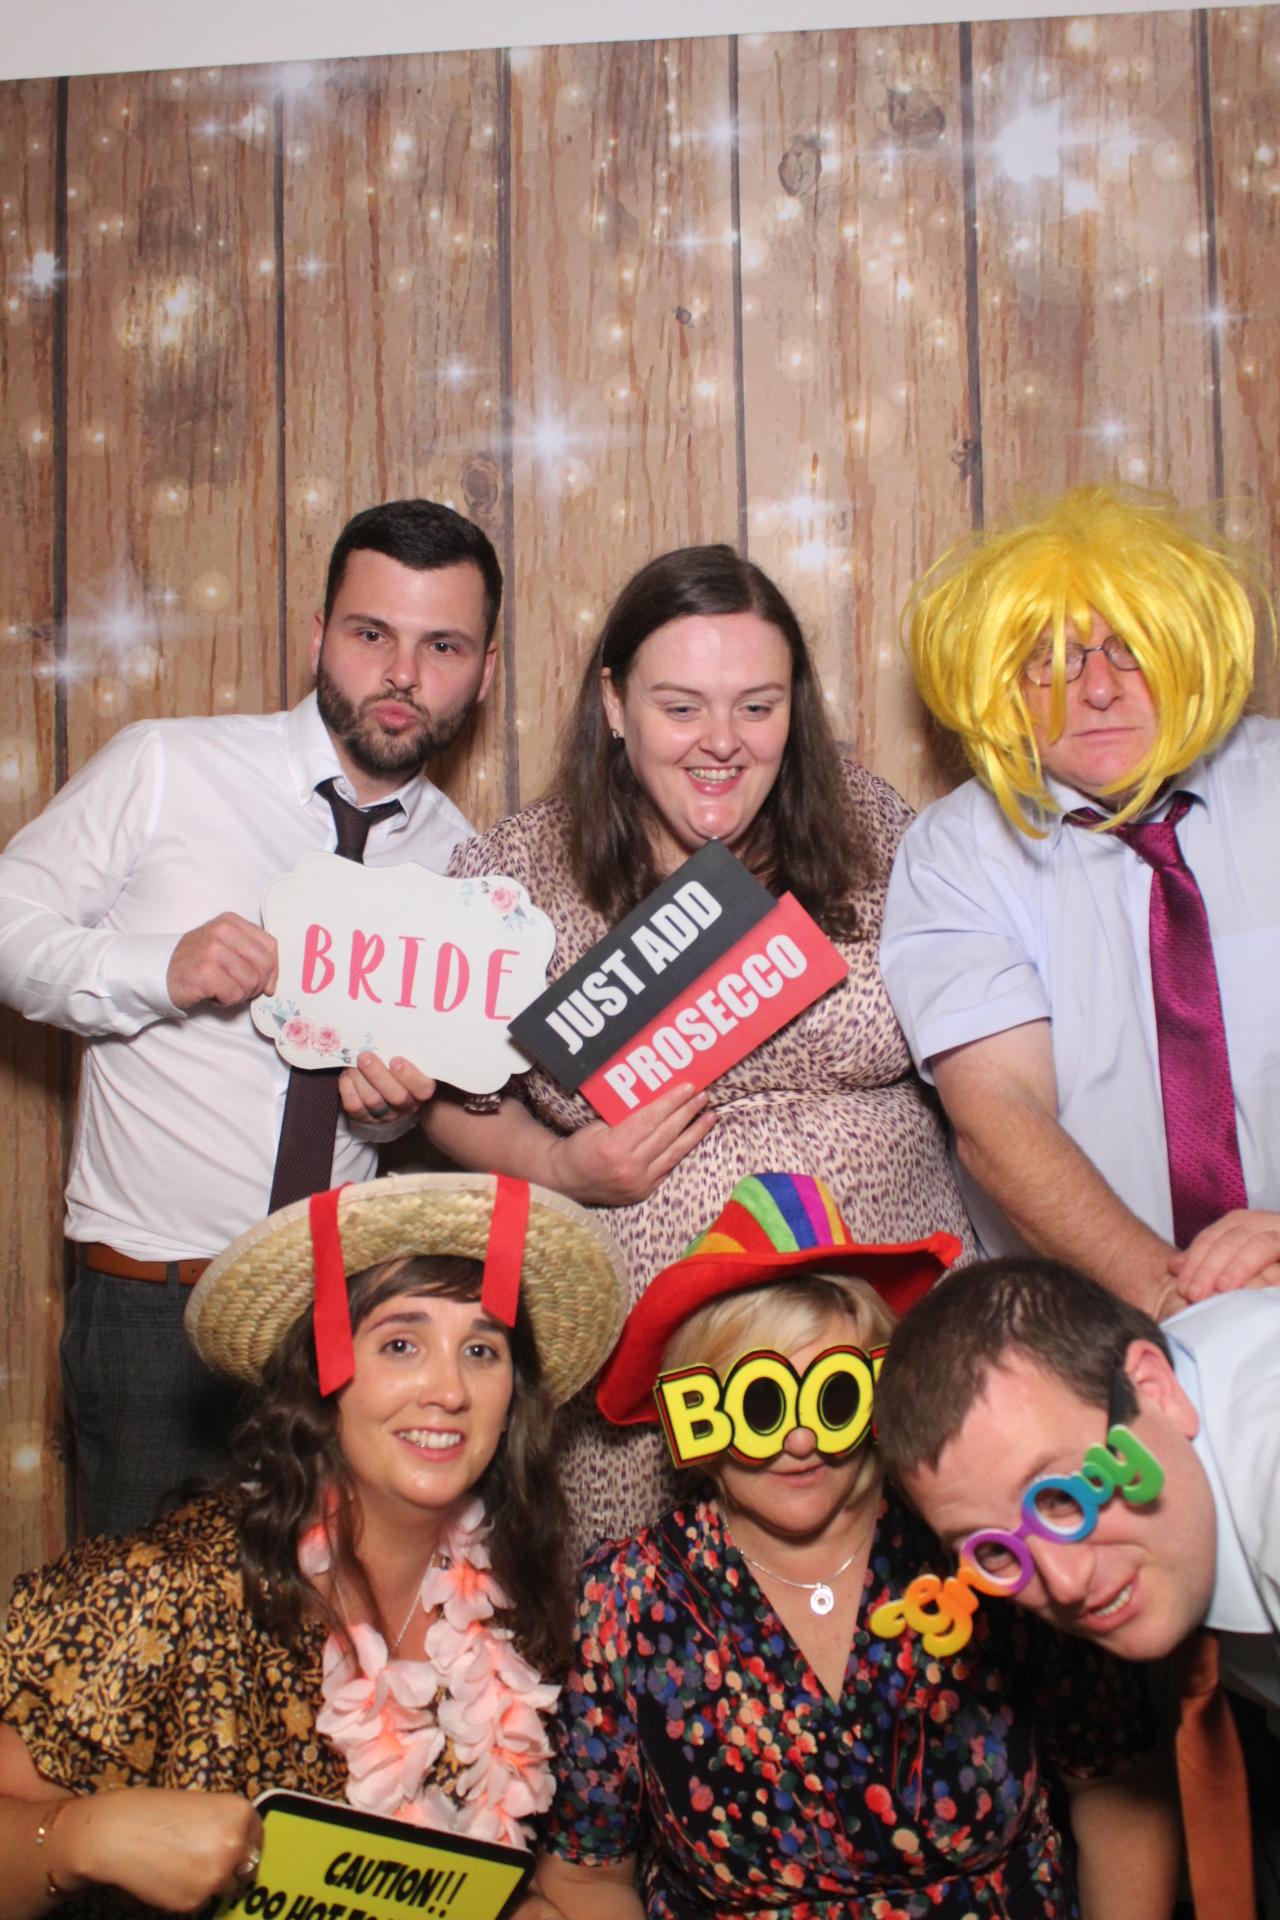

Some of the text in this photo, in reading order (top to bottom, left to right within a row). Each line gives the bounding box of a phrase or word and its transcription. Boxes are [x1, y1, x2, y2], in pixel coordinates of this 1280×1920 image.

[301, 923, 521, 1021] BRIDE
[544, 880, 723, 1055] JUST ADD
[603, 933, 807, 1109] PROSECCO
[655, 1344, 887, 1468] BOO
[324, 1852, 468, 1917] CAUTION!!
